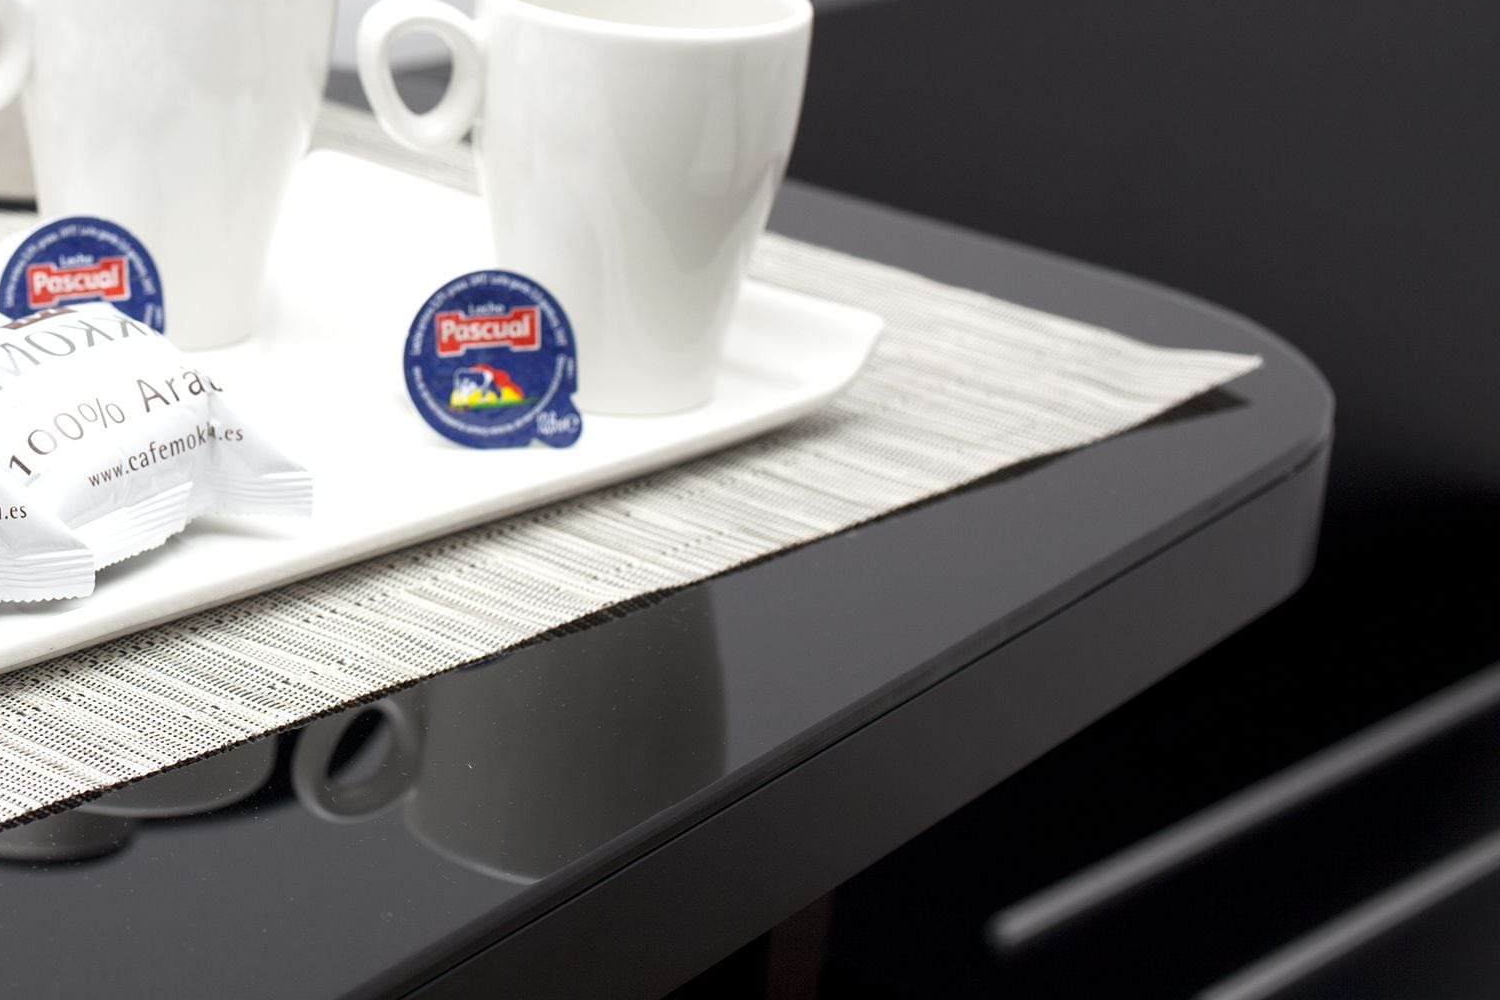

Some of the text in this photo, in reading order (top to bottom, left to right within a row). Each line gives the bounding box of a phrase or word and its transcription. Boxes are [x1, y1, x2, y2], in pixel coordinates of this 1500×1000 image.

[32, 264, 120, 296] Pascual
[439, 313, 530, 344] Pascual
[8, 398, 126, 476] 100%
